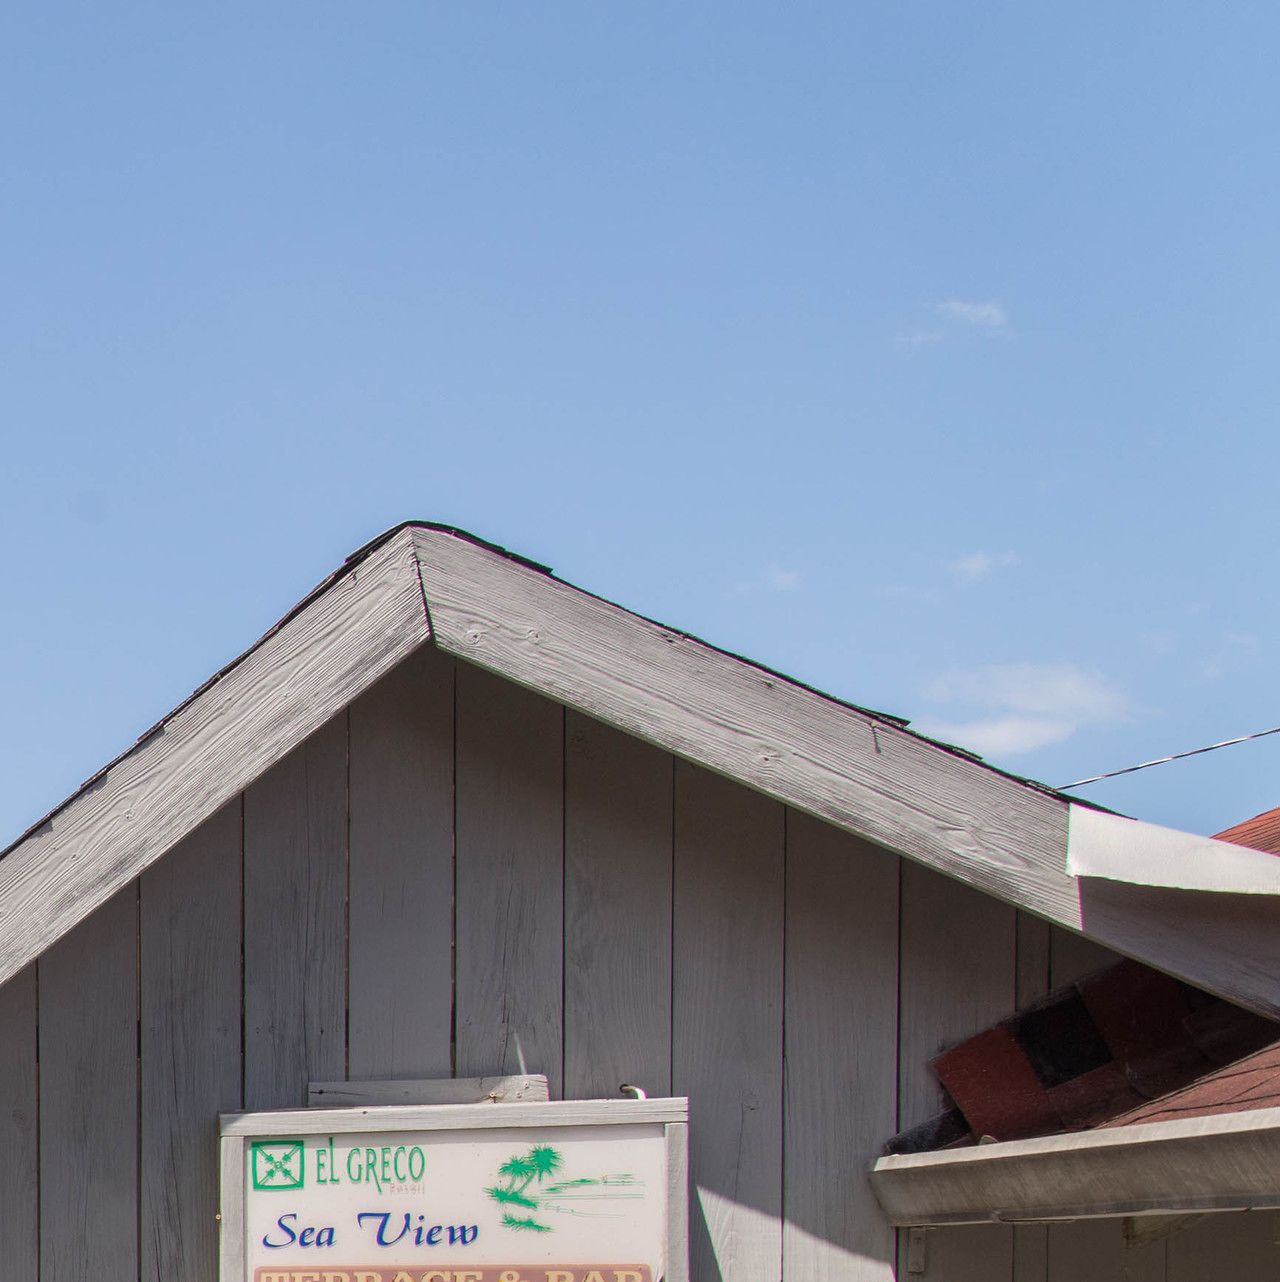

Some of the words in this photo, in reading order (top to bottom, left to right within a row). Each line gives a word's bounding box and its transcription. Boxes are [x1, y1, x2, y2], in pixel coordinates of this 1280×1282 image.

[346, 1146, 426, 1193] GRECO
[262, 1213, 338, 1248] Sea
[357, 1212, 479, 1247] View
